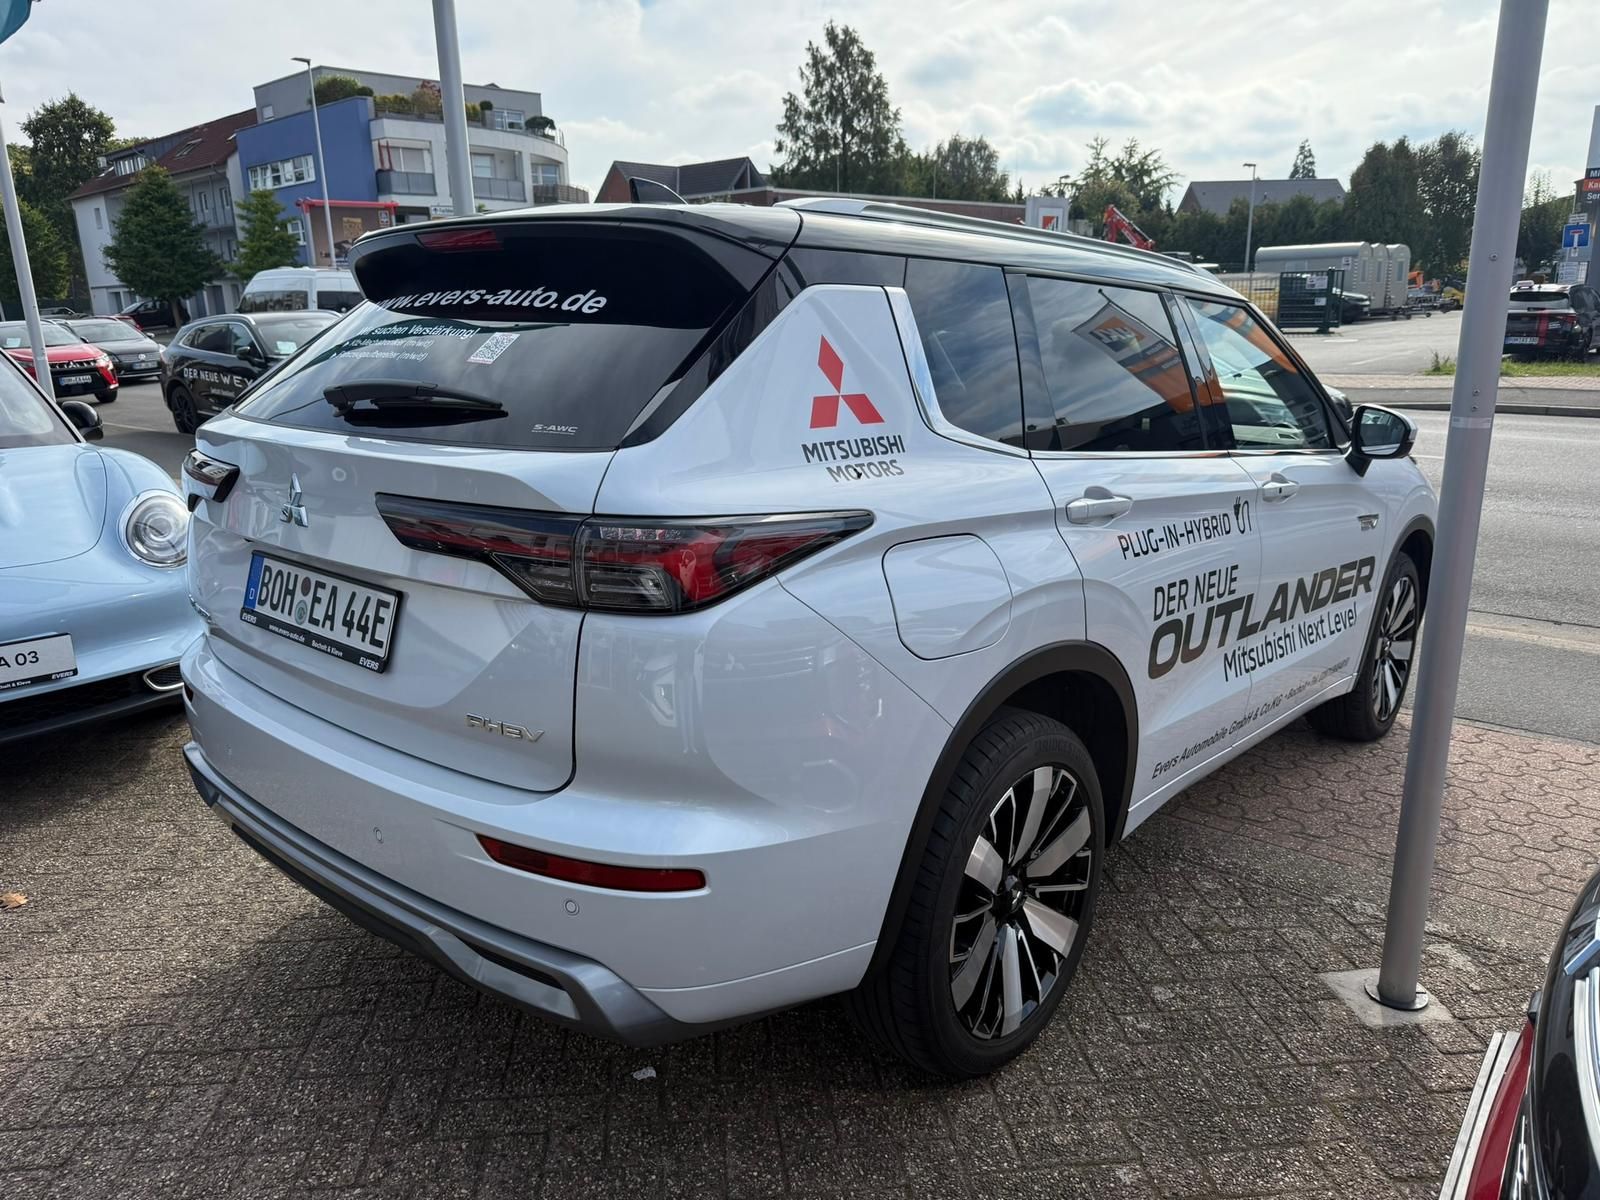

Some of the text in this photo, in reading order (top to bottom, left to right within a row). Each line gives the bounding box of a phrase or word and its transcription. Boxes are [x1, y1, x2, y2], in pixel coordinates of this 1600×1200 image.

[372, 325, 409, 335] suchen
[408, 324, 481, 340] Verstärkung!
[183, 367, 199, 379] DER
[200, 370, 220, 383] NEUE
[533, 423, 578, 433] S-AWC
[801, 434, 906, 463] MITSUBISHI
[825, 459, 904, 483] MOTORS
[1117, 512, 1231, 560] PLUG-IN-HYBRID
[1153, 564, 1239, 622] DER NEUE
[241, 612, 258, 624] EVERS
[257, 565, 391, 649] BOH EA 44E
[1147, 555, 1376, 680] OUTLANDER
[1223, 625, 1297, 682] Mitsubishi
[1298, 614, 1327, 647] Next
[1327, 602, 1358, 636] Level
[15, 650, 40, 666] 03
[359, 656, 380, 671] EVERS
[51, 671, 74, 680] EVERS
[466, 712, 545, 742] PHEV
[1152, 755, 1178, 779] Evers
[1179, 728, 1228, 762] Automobile
[1228, 712, 1253, 737] GmbH
